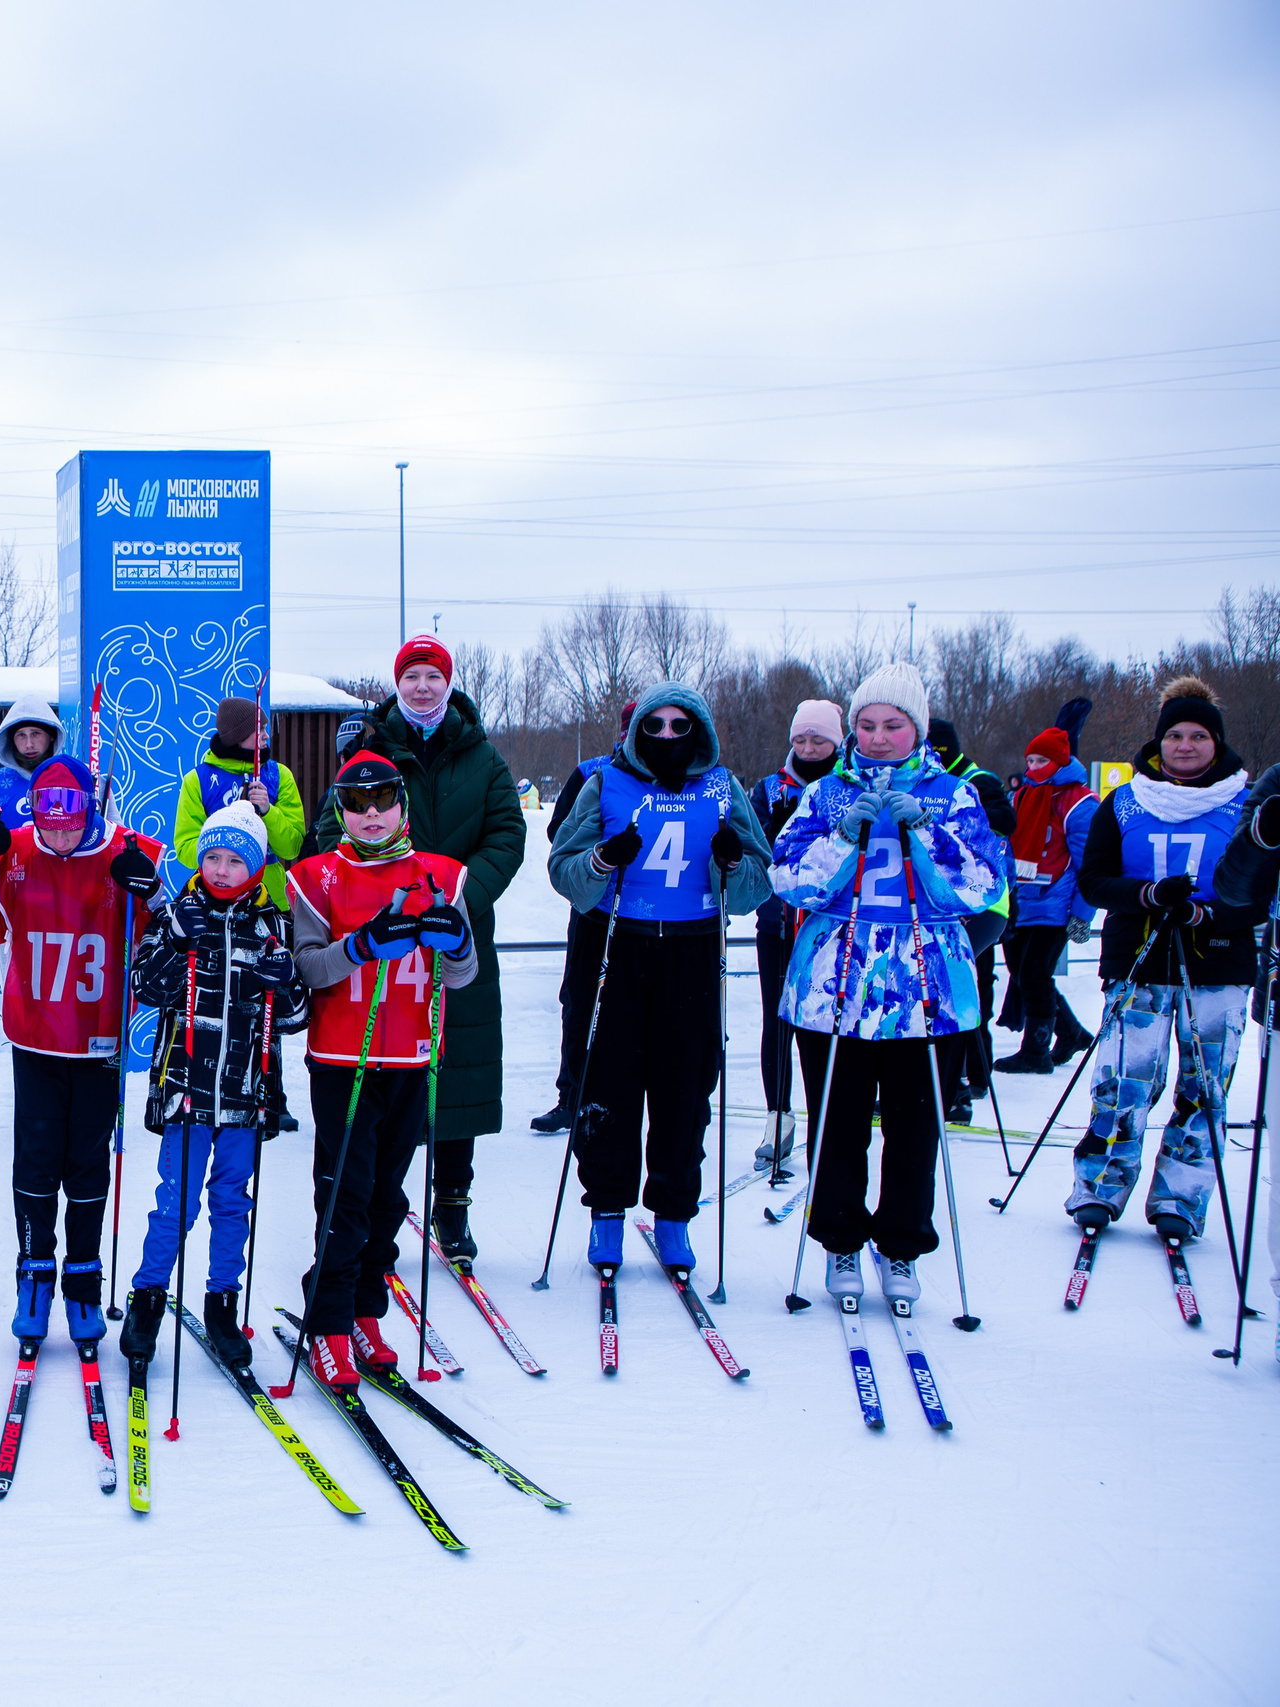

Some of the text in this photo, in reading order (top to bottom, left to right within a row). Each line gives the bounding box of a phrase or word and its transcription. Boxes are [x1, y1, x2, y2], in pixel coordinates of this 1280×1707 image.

[166, 478, 260, 498] МОСКОВСКАЯ
[166, 499, 219, 518] ЛЫЖНЯ
[113, 541, 242, 555] ЮГО-ВОСТОК
[656, 793, 696, 801] ЛЫЖНЯ
[656, 804, 686, 812] МОЭК
[923, 796, 949, 805] ЛЫЖН
[642, 821, 691, 888] 4
[860, 837, 903, 907] 2
[1147, 833, 1207, 886] 17
[388, 923, 417, 931] NORDSKI
[422, 917, 452, 925] NORDSKI
[841, 911, 857, 979] VUOKATTI
[912, 917, 928, 987] VUOKATTI
[27, 931, 106, 1003] 173
[185, 967, 193, 1028] MADSHUS
[262, 1003, 272, 1054] MADSHUS
[360, 1005, 378, 1059] Sable
[602, 1324, 615, 1334] A3
[696, 1311, 710, 1328] ACTIVE
[703, 1328, 719, 1340] A3
[855, 1365, 879, 1407] DENTON
[914, 1369, 942, 1411] DENTON
[132, 1398, 145, 1420] SKATE
[260, 1404, 285, 1425] SKATE
[133, 1445, 147, 1488] BRADOS
[295, 1452, 338, 1491] BRADOS
[397, 1480, 461, 1549] FISCHER
